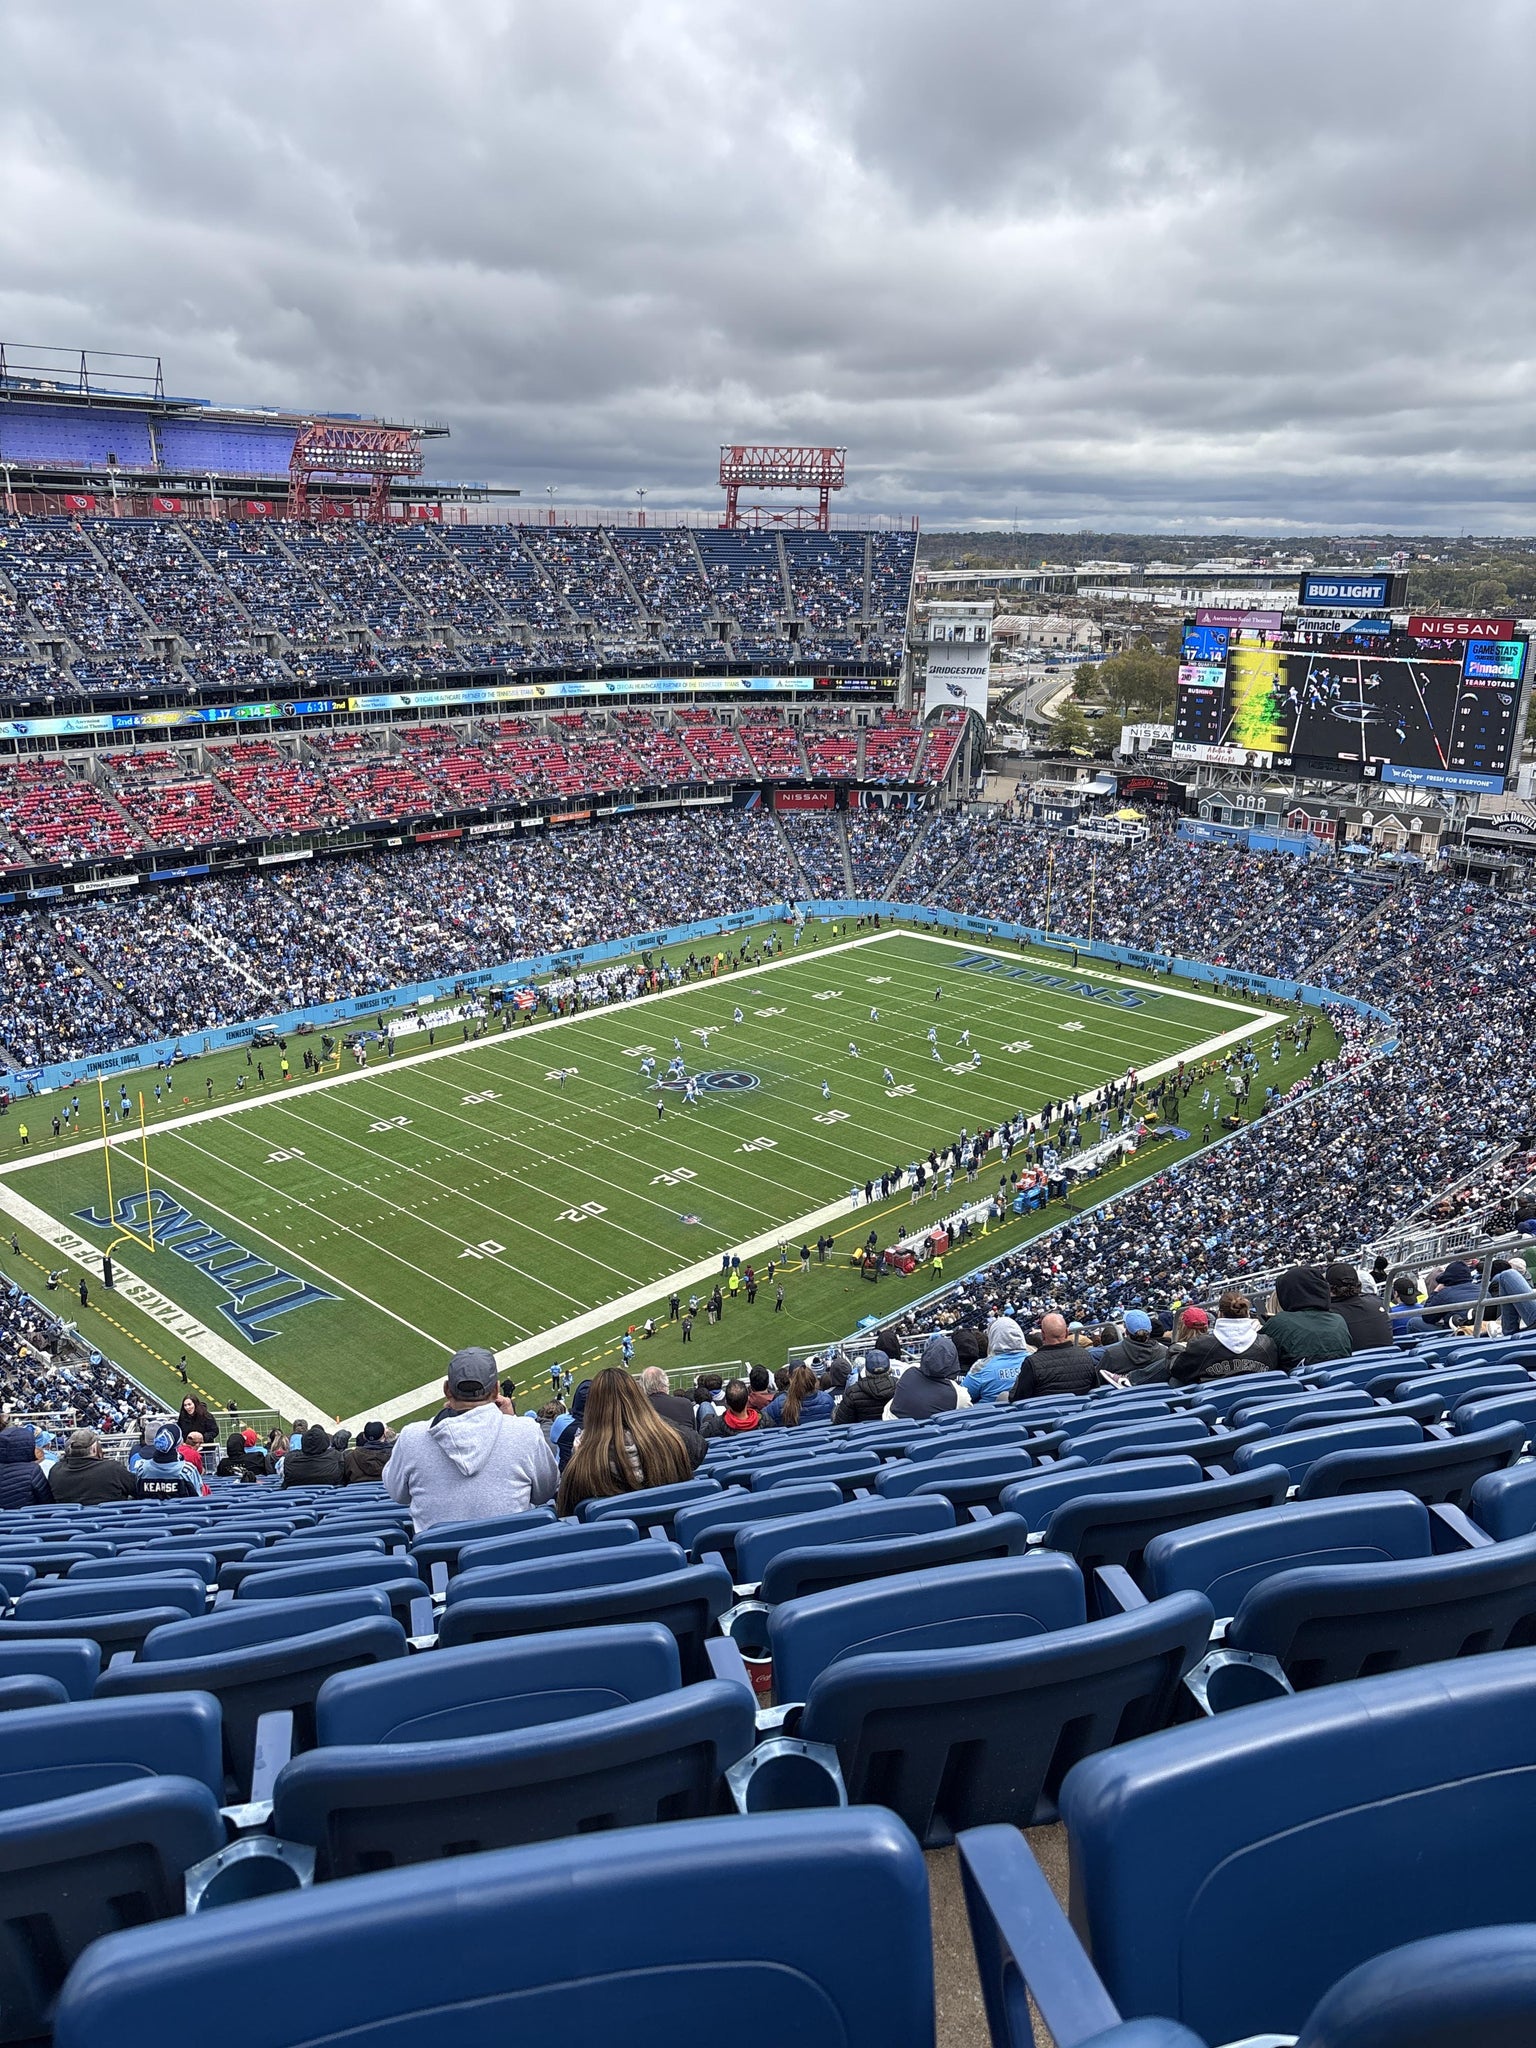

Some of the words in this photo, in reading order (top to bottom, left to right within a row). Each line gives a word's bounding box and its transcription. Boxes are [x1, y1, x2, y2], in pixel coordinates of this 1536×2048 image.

[1309, 585, 1338, 597] BUD
[1339, 586, 1382, 598] LIGHT
[1298, 618, 1341, 631] Pinnacle
[1421, 622, 1499, 635] NISSAN
[1186, 650, 1197, 660] 17
[1210, 651, 1222, 661] 14
[1473, 645, 1494, 654] GAME
[1495, 645, 1519, 656] STATS
[928, 665, 988, 675] BRIDGESTONE
[1469, 661, 1514, 675] Pinnacle
[1181, 673, 1192, 681] 2ND
[249, 706, 261, 716] 14
[307, 701, 328, 712] 6:31
[332, 701, 345, 709] 2nd
[219, 709, 231, 719] 17
[116, 717, 133, 726] 2nd
[141, 716, 152, 725] 23
[1174, 743, 1197, 752] MARS
[1401, 769, 1423, 783] Kroger
[1426, 774, 1444, 783] FRESH
[1445, 775, 1458, 784] FOR
[1459, 777, 1490, 787] EVERYONE
[782, 793, 828, 801] NISSAN
[1044, 809, 1063, 822] lite
[1491, 813, 1510, 826] JACK
[940, 950, 1164, 1009] TITANS
[1225, 973, 1250, 986] TENNESSEE
[1251, 977, 1267, 989] TOUGH
[354, 1000, 380, 1011] TENNESSEE
[621, 1044, 656, 1057] 50
[86, 1058, 120, 1073] TENNESSEE
[943, 1061, 978, 1076] 30
[463, 1089, 504, 1106] 30
[884, 1083, 918, 1099] 40
[812, 1108, 851, 1125] 50
[370, 1115, 414, 1133] 20
[740, 1136, 779, 1154] 40
[269, 1146, 306, 1162] 10
[655, 1166, 699, 1187] 30
[560, 1200, 609, 1222] 20
[53, 1234, 83, 1250] US
[464, 1239, 507, 1260] 10
[73, 1251, 104, 1264] OF
[70, 1188, 344, 1345] TITANS
[126, 1285, 184, 1325] TAKES
[176, 1324, 207, 1340] IT
[143, 1482, 179, 1493] KEARSE
